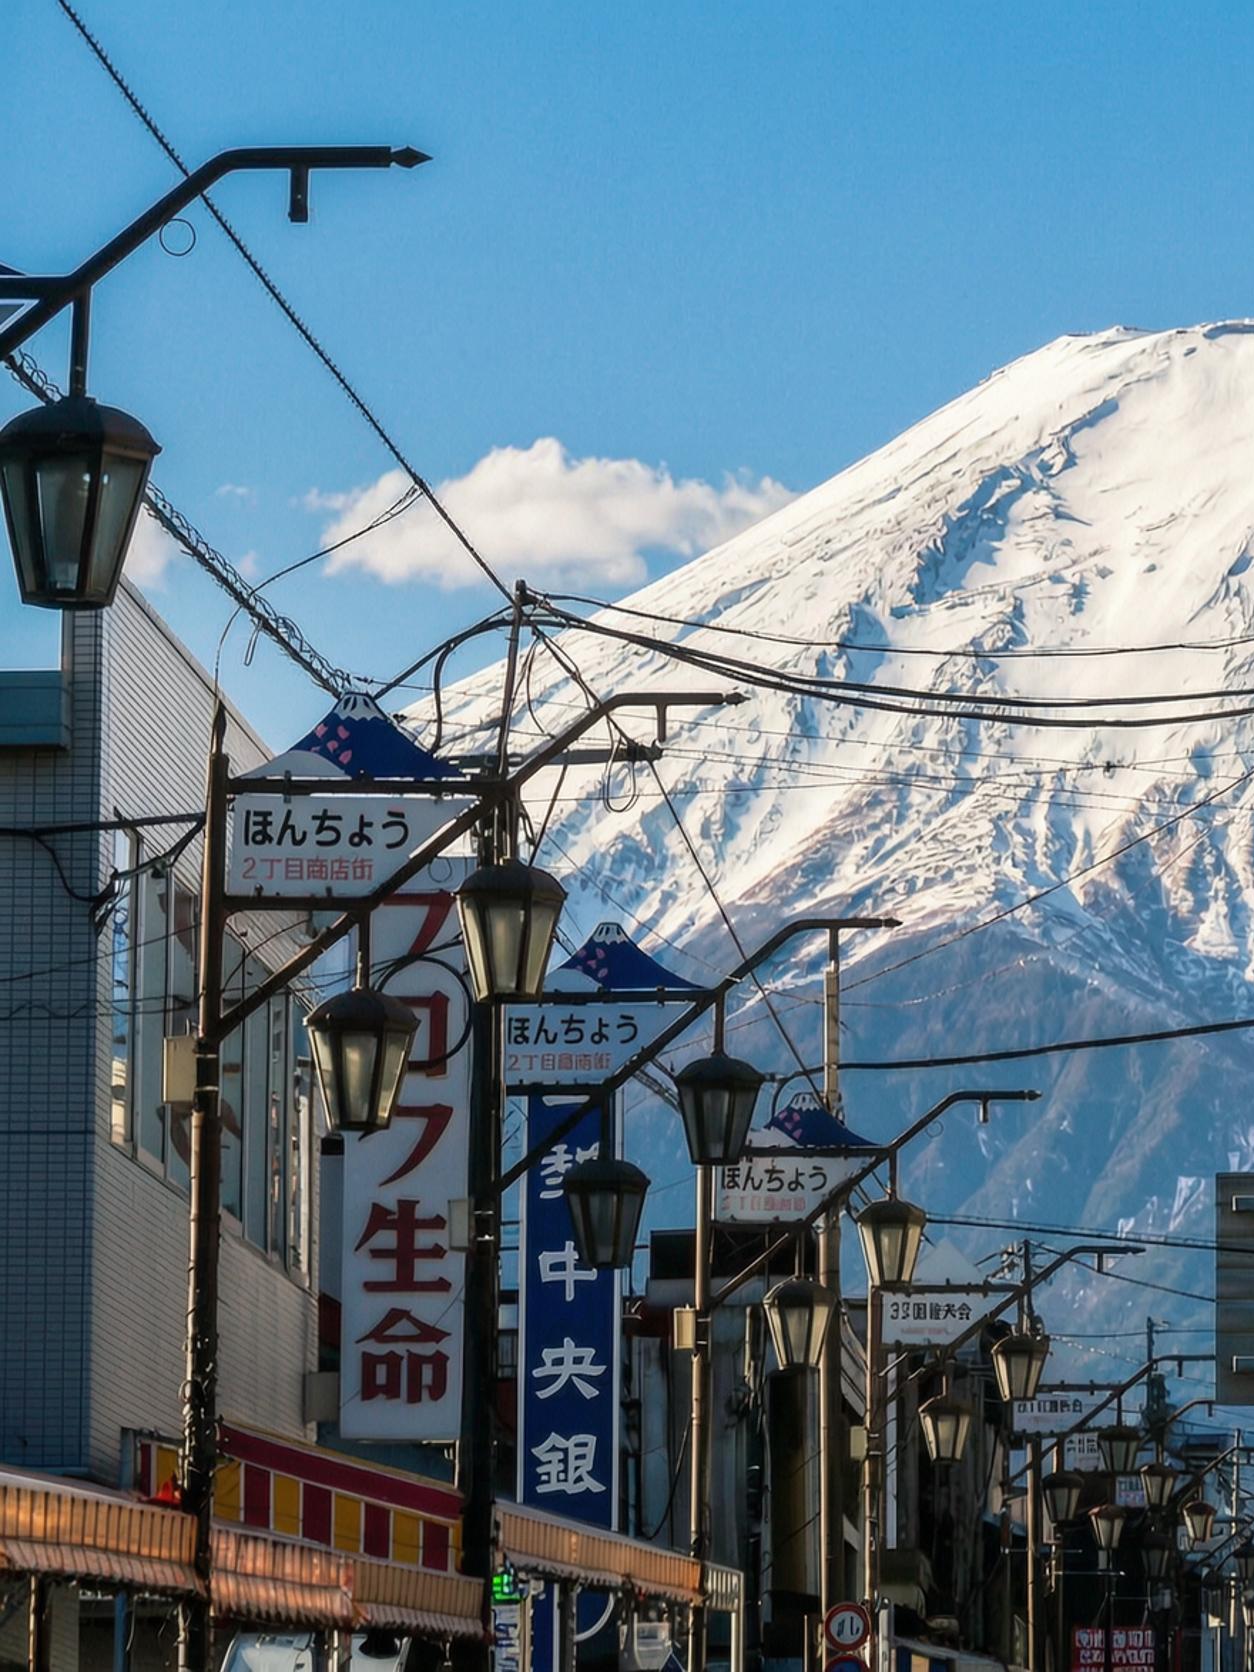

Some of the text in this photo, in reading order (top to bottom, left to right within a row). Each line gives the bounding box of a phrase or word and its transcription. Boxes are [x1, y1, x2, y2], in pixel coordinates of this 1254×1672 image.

[243, 809, 409, 847] ほんちょう
[507, 1014, 638, 1046] ほんちょう
[721, 1165, 828, 1193] ほんちょう
